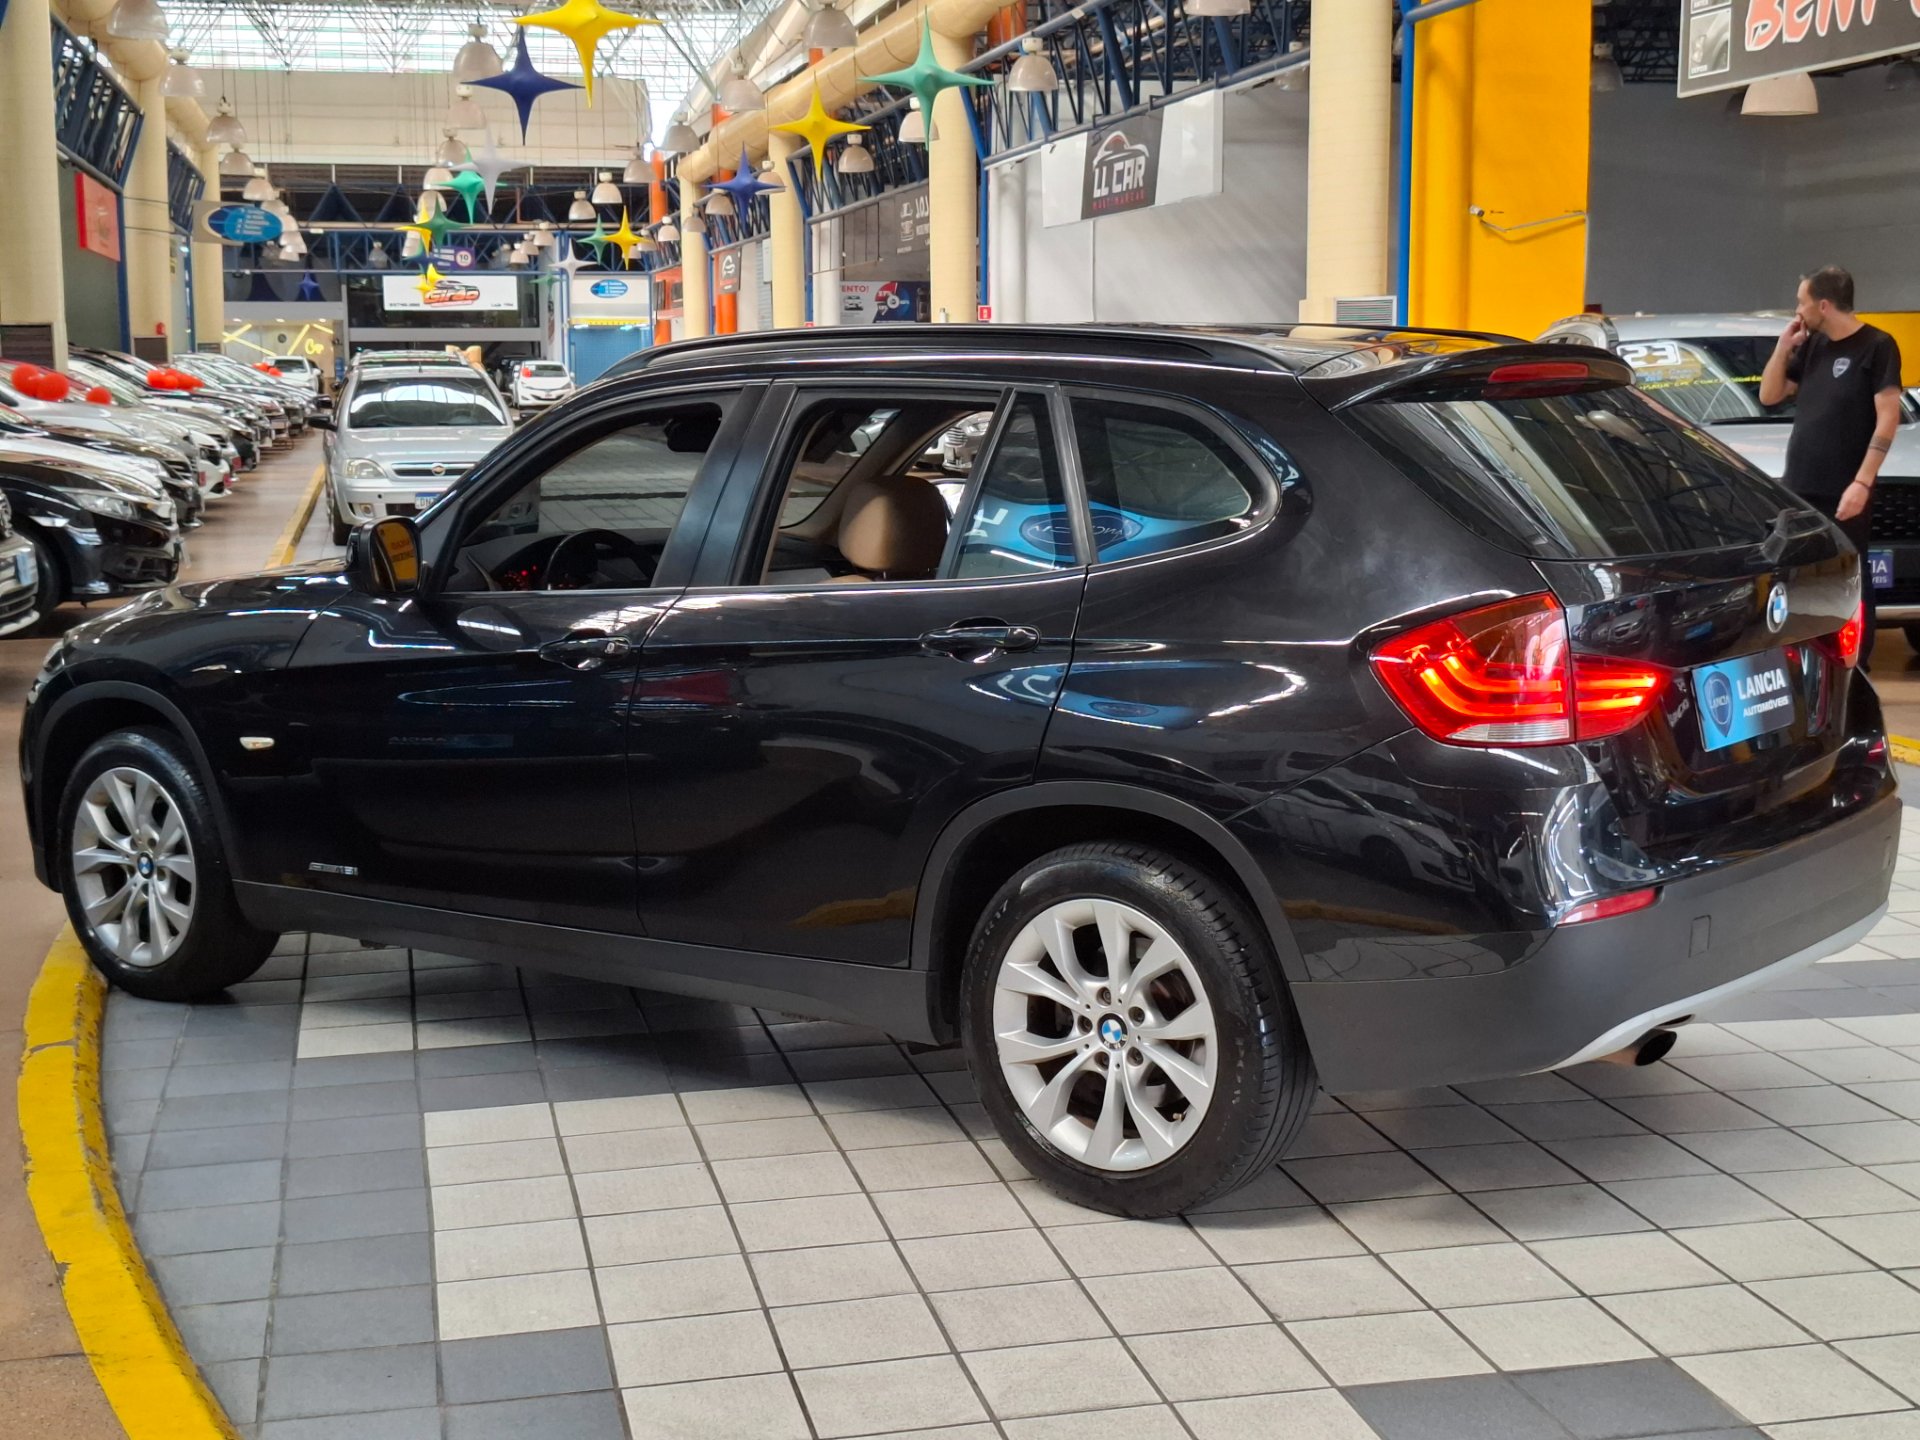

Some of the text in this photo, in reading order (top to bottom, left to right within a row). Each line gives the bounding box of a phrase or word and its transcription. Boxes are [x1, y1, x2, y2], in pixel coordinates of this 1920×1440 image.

[1093, 155, 1146, 199] LL CAR
[1736, 667, 1787, 700] LANCIA
[1743, 695, 1789, 718] AUTOMÓVEIS
